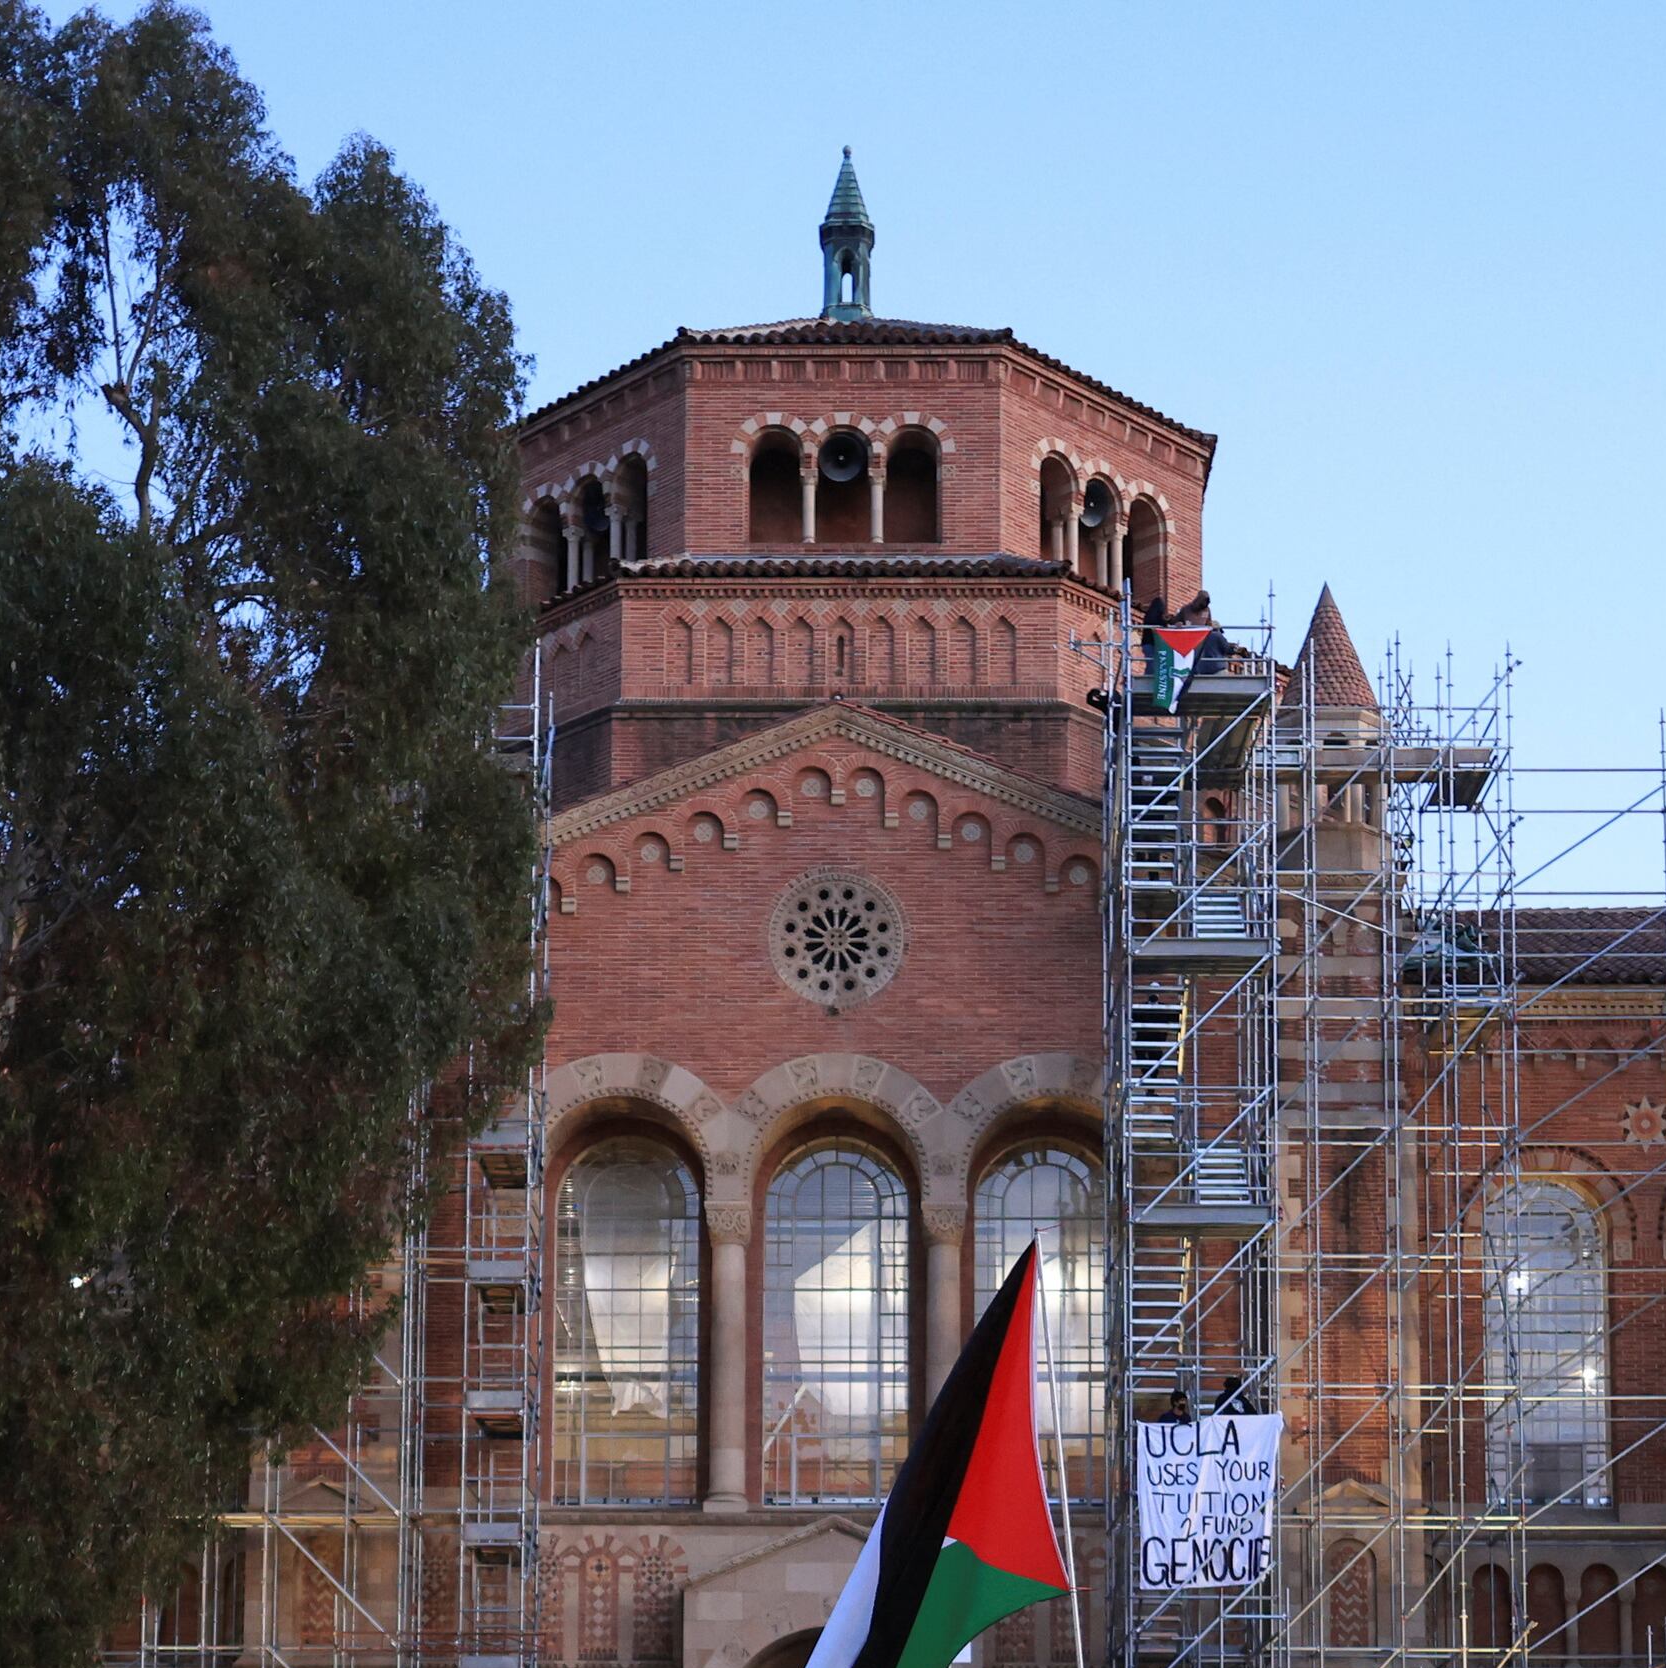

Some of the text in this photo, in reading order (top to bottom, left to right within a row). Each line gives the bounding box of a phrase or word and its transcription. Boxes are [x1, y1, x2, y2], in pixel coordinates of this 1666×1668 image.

[1145, 1420, 1240, 1458] UCLA
[1146, 1459, 1271, 1487] USES YOUR
[1151, 1491, 1265, 1517] TUITION
[1180, 1515, 1254, 1538] 2 FUND
